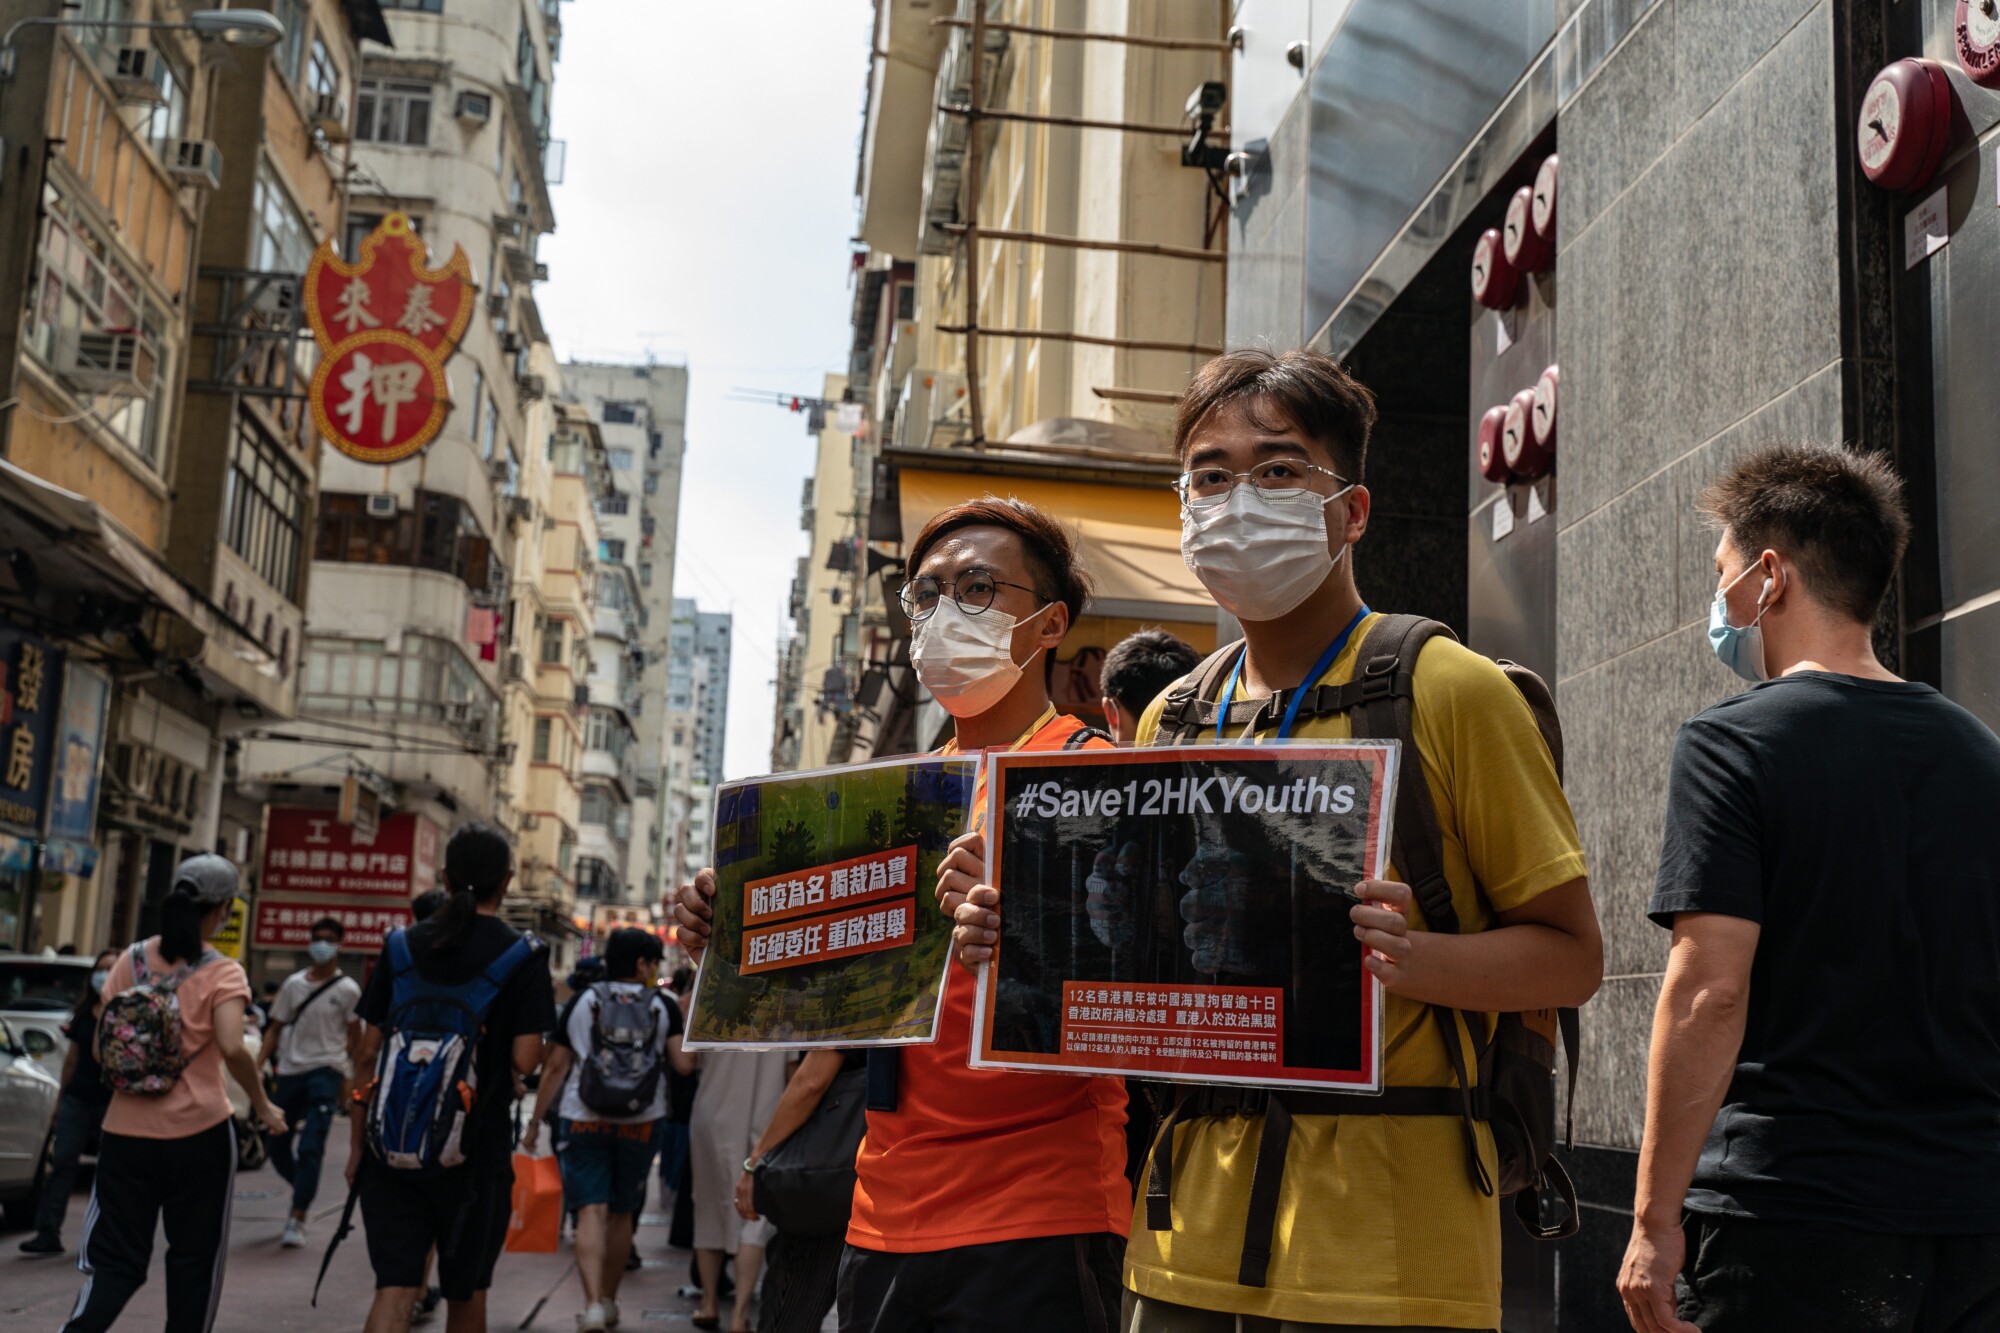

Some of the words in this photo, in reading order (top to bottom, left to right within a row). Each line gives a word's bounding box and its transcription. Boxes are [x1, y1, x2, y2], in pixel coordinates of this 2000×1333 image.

[336, 352, 424, 443] 押
[1016, 777, 1356, 818] #Save12HKYouths
[751, 875, 825, 916] 防疫為名
[830, 855, 908, 900] 獨裁為實
[748, 924, 823, 965] 拒絕委任
[1068, 1006, 1167, 1024] 香港政府消極冷處理
[1176, 1010, 1277, 1028] 置港人於政治黑獄
[1070, 990, 1276, 1010] 12名香港青年被中國海警拘留逾十日
[1162, 1036, 1276, 1051] 立即交回12名被拘留的香港青年
